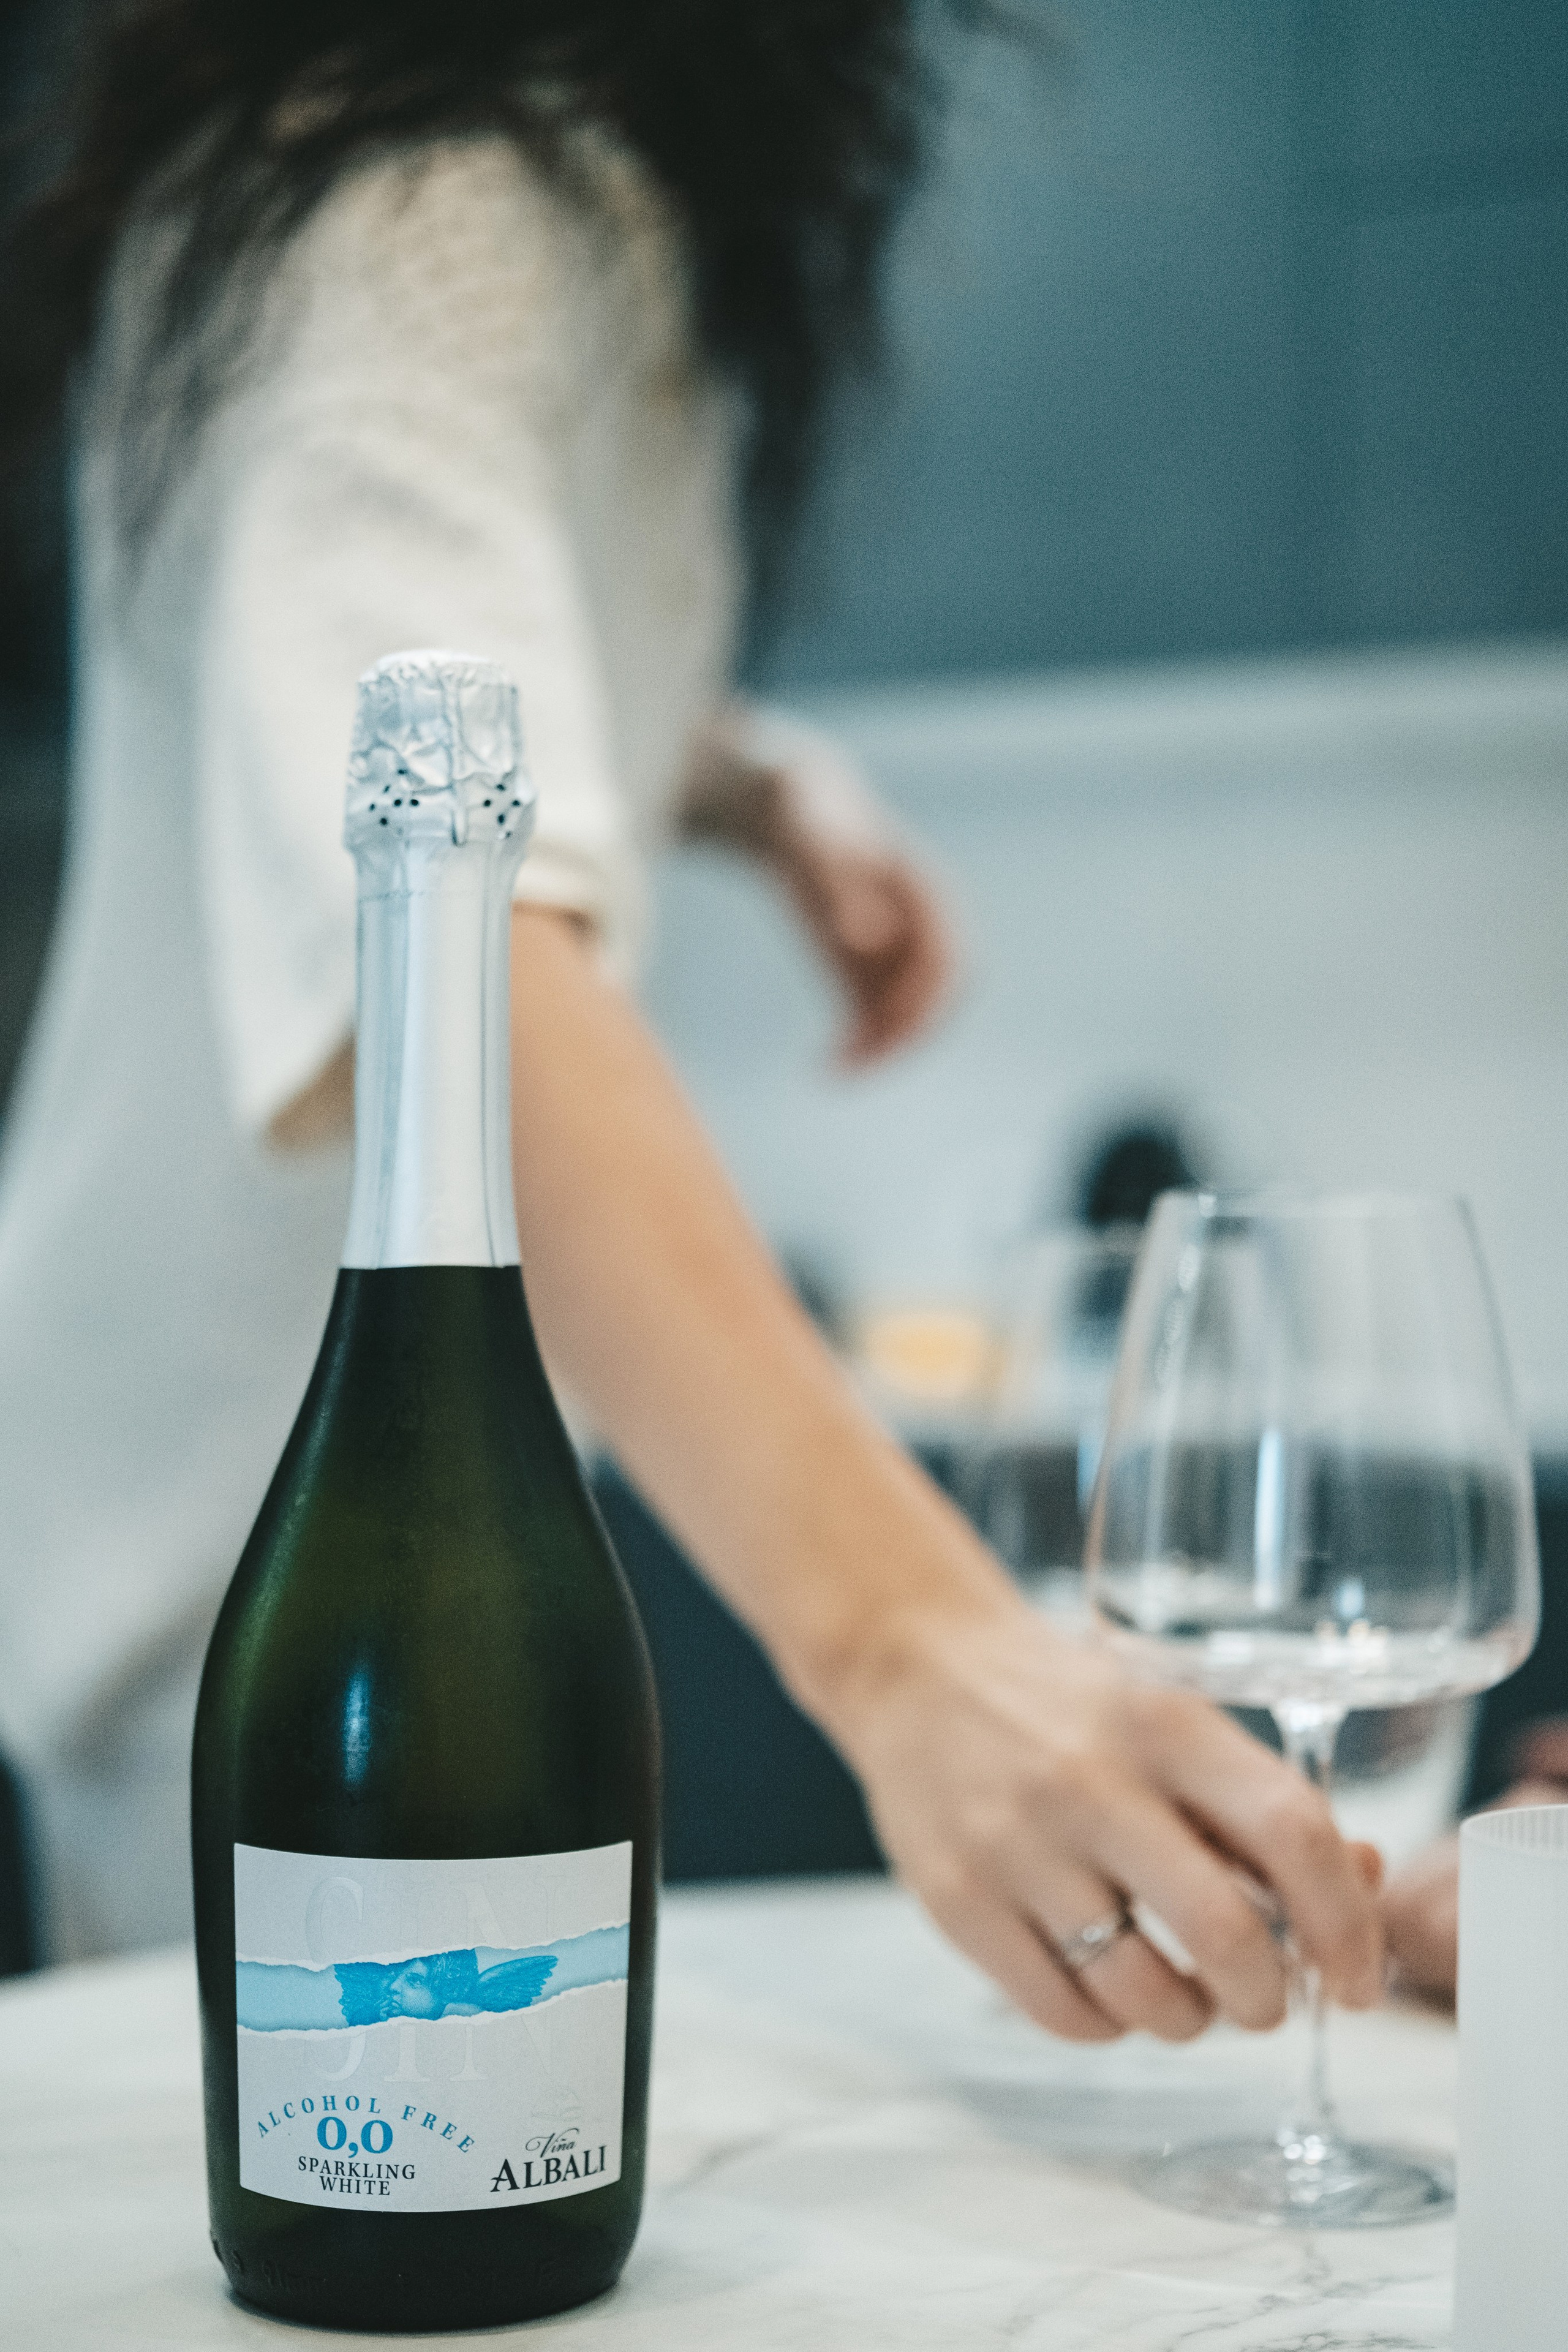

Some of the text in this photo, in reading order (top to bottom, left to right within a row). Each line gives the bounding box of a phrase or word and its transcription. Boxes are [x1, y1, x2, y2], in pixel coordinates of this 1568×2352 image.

[257, 2095, 475, 2154] ALCOHOL FREE
[316, 2116, 394, 2158] 0,0
[525, 2127, 580, 2158] Viña
[298, 2155, 416, 2180] SPARKLING
[318, 2175, 391, 2196] WHITE
[490, 2145, 607, 2193] ALBALI
